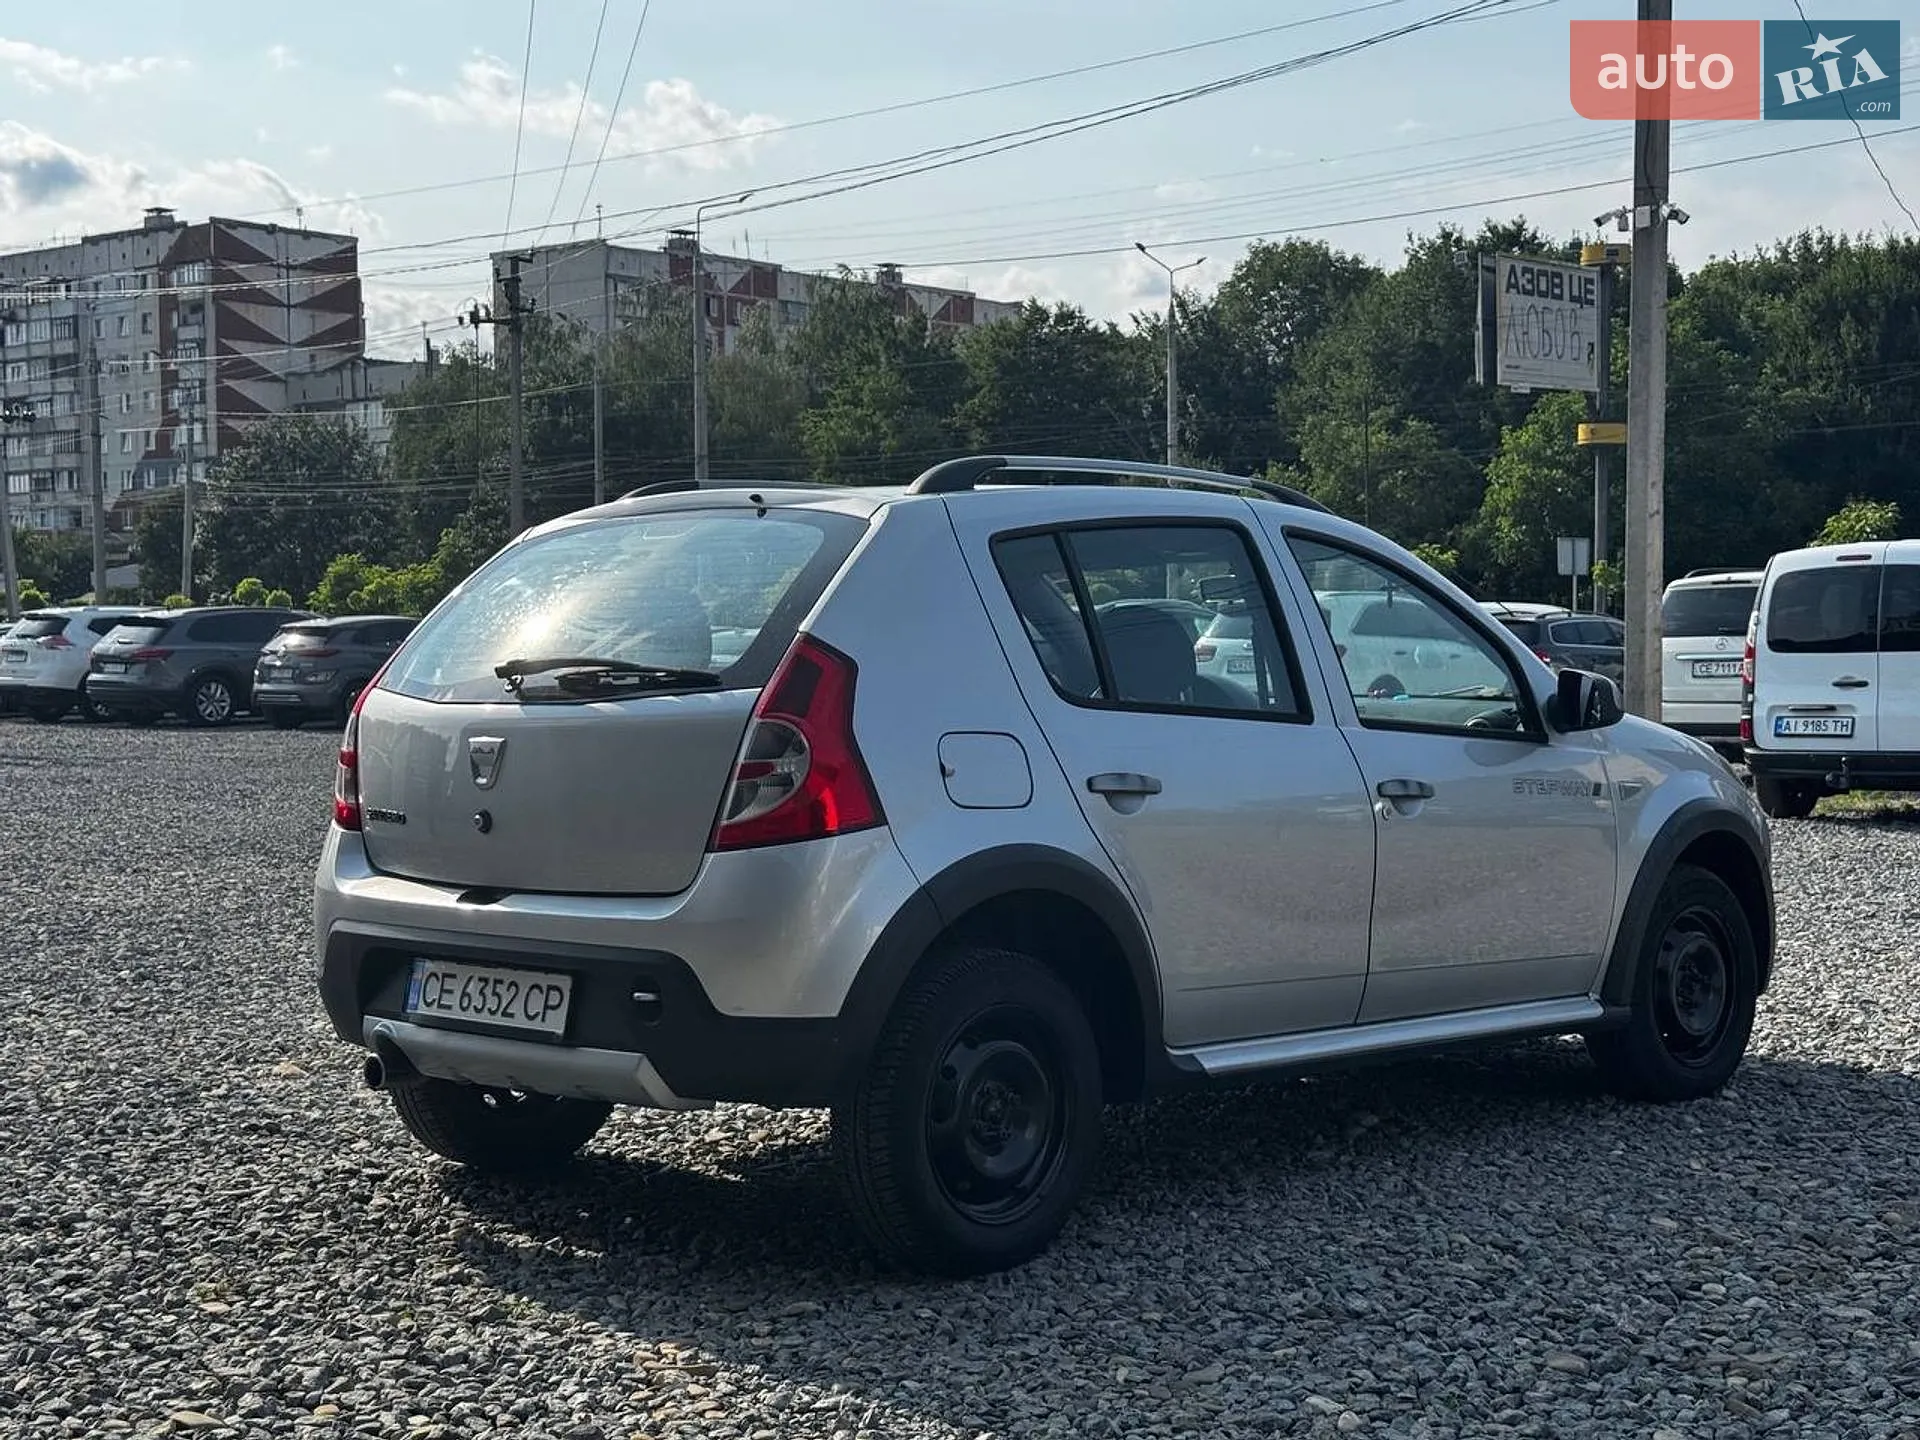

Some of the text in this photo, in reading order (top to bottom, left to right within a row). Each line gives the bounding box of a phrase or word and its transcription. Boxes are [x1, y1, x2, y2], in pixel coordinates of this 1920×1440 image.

[1505, 263, 1595, 309] АЗОВ ЦЕ
[1783, 719, 1850, 732] AI 9185 TH
[423, 971, 564, 1023] CE 6352 CP
